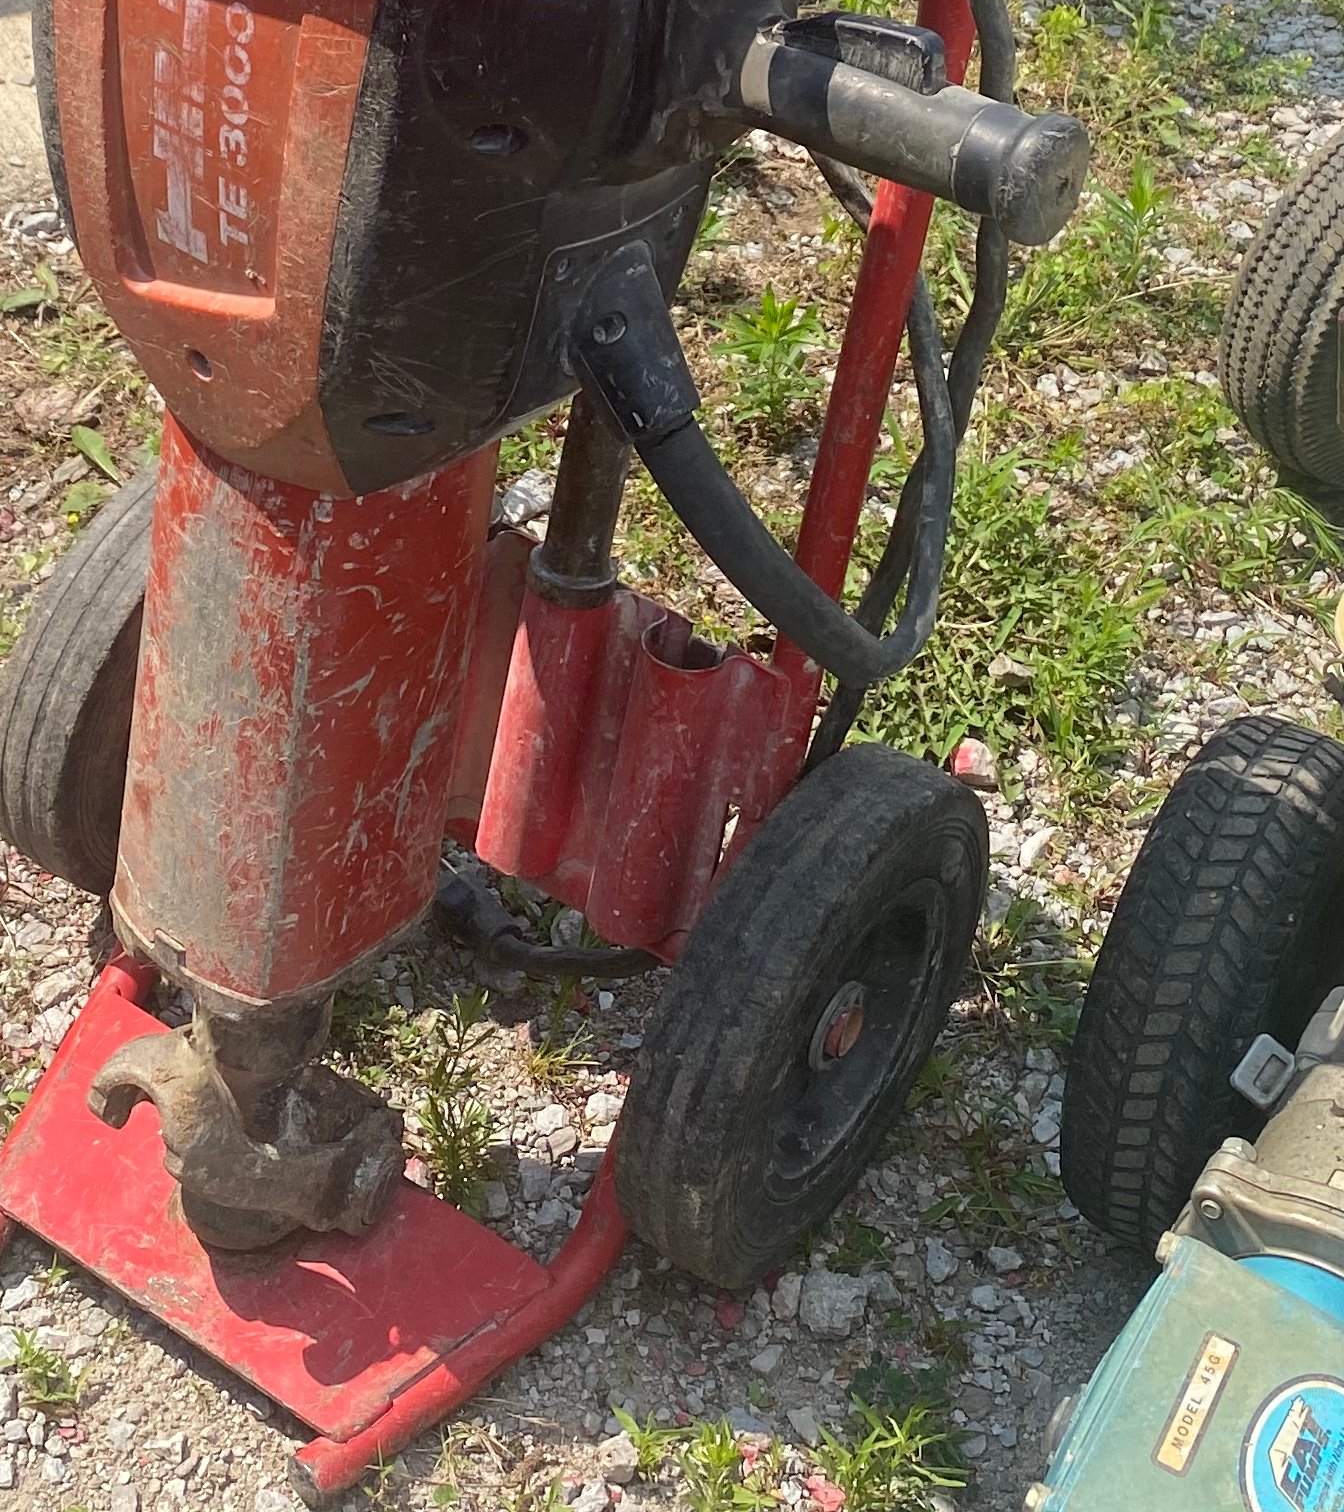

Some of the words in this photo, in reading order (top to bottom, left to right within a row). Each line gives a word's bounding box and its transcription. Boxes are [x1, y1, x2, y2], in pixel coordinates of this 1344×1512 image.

[218, 176, 249, 247] TE
[1172, 1396, 1203, 1450] MODEL
[1201, 1354, 1220, 1385] 45G
[1280, 1405, 1321, 1499] CAT
